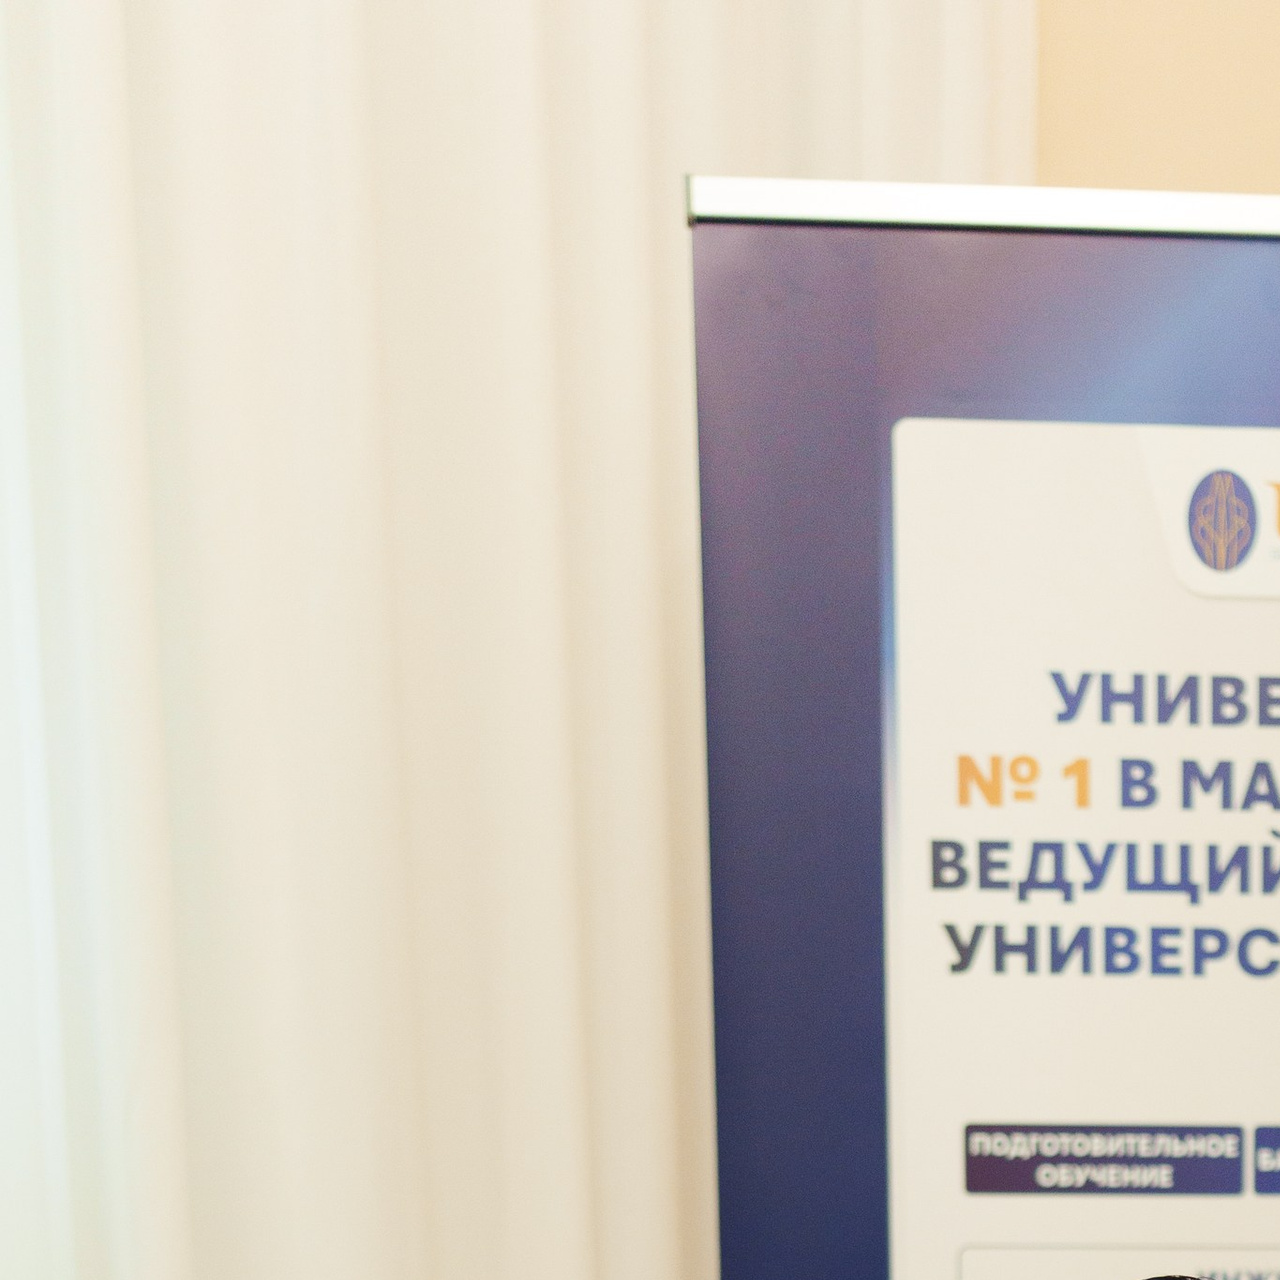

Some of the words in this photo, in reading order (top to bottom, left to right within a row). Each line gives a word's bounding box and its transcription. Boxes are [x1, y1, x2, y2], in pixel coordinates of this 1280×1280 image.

[956, 754, 1041, 807] №
[1062, 758, 1092, 808] 1
[1118, 758, 1158, 810] В
[968, 1131, 1240, 1160] ПОДГОТОВИТЕЛЬНОЕ
[1034, 1163, 1175, 1189] ОБУЧЕНИЕ
